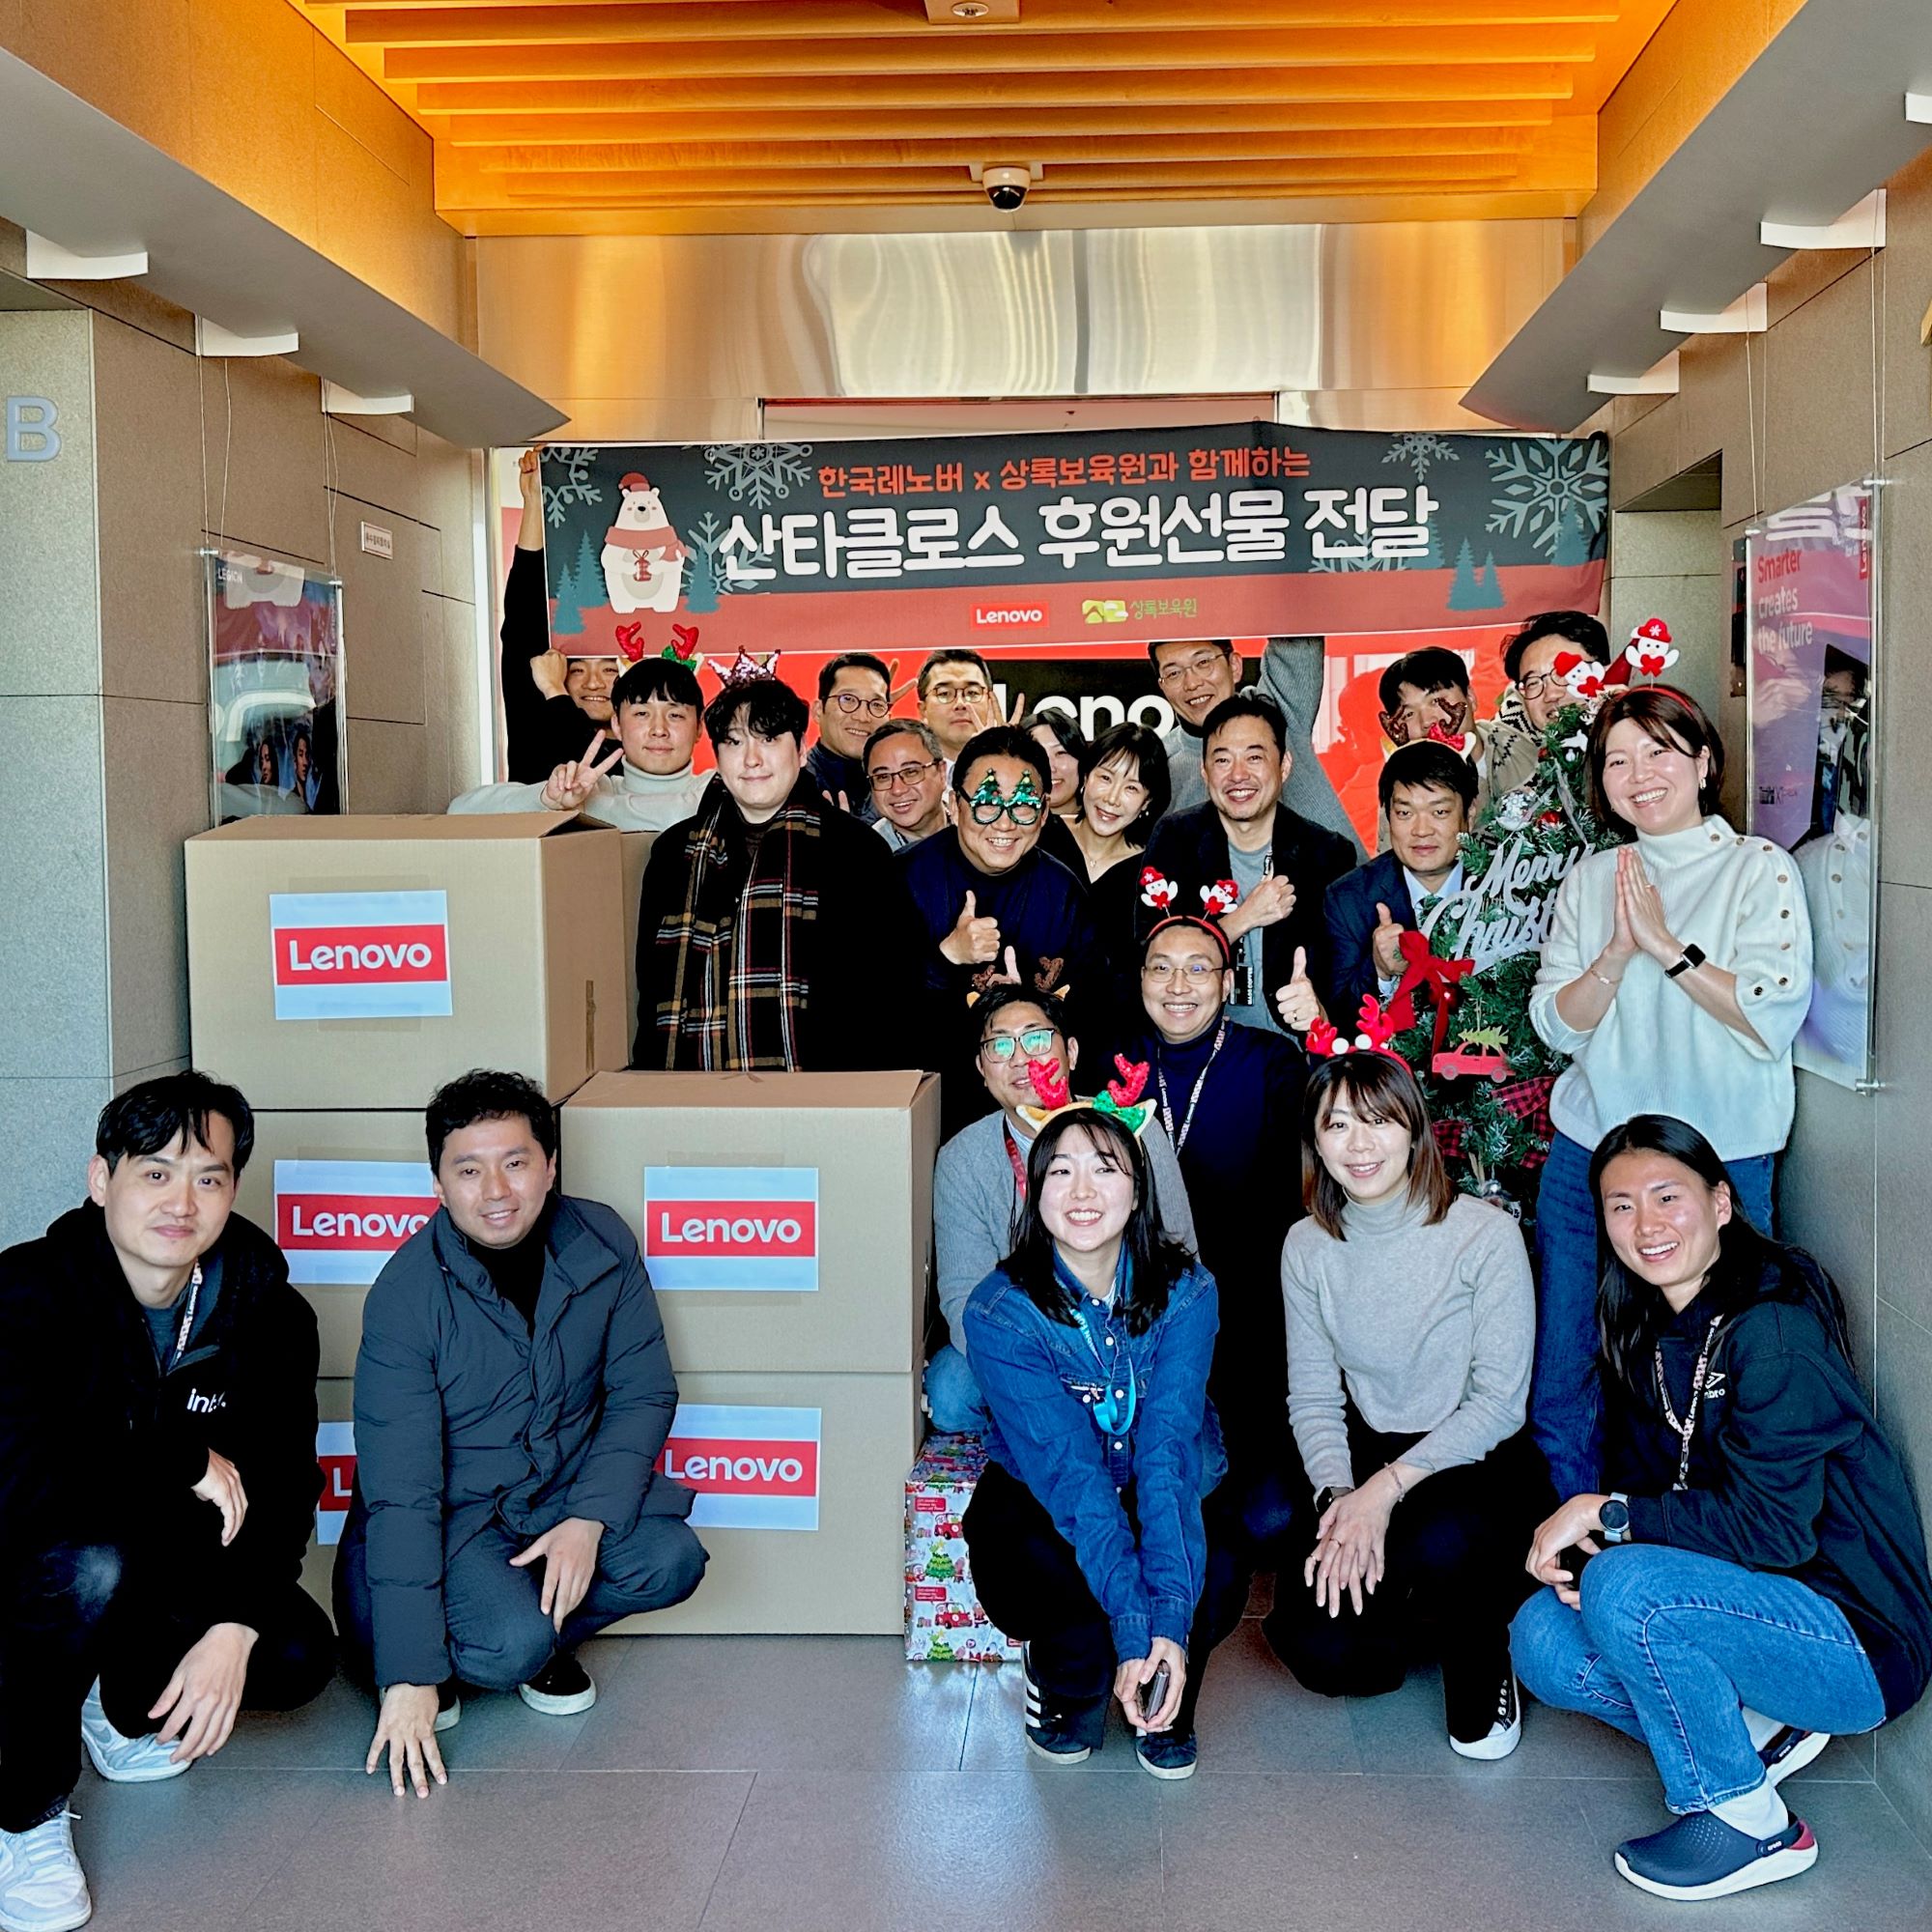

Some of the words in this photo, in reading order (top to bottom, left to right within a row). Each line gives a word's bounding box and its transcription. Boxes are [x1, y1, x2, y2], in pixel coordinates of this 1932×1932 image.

[7, 396, 62, 462] B
[818, 462, 963, 498] 한국레노버
[1000, 451, 1179, 490] 상록보육원과
[1188, 446, 1311, 481] 함께하는
[719, 505, 1025, 580] 산타클로스
[1037, 489, 1291, 569] 후원선물
[1303, 483, 1439, 558] 전달
[1758, 550, 1803, 583] Smarter
[976, 607, 1042, 625] Lenovo
[1129, 598, 1198, 620] 상록보육원
[1758, 586, 1799, 619] creates
[1758, 626, 1776, 653] the
[1778, 620, 1813, 646] future
[289, 940, 433, 971] Lenovo
[662, 1212, 802, 1243] Lenovo
[665, 1450, 803, 1482] Lenovo
